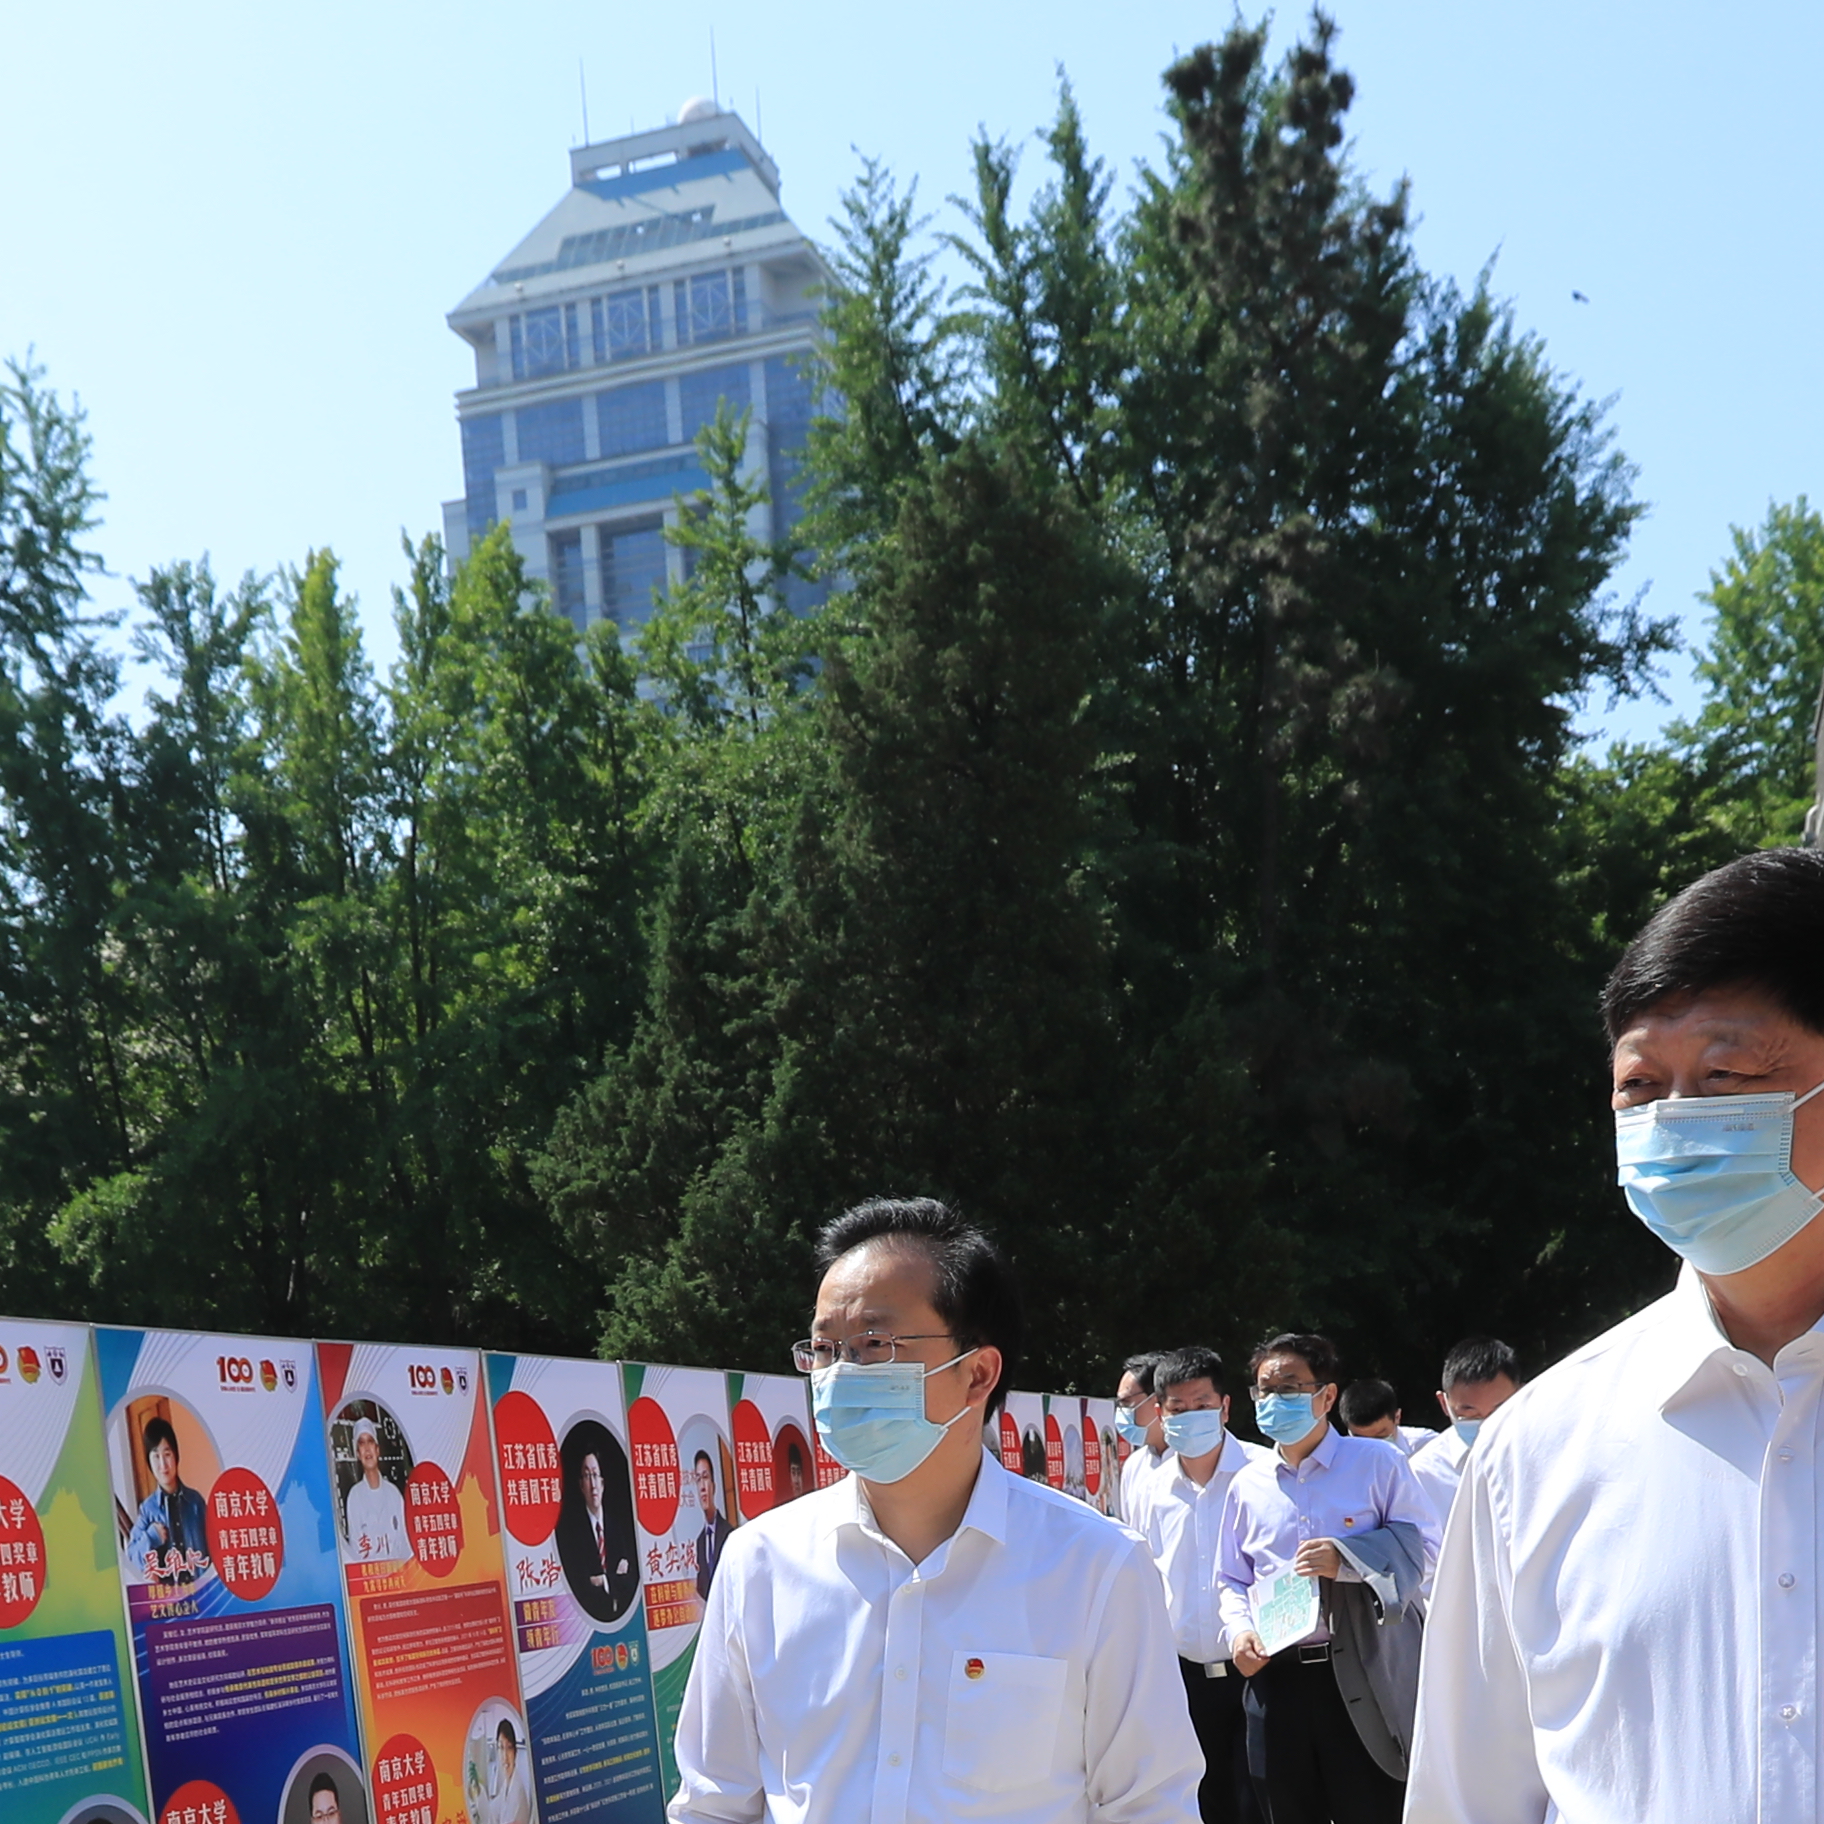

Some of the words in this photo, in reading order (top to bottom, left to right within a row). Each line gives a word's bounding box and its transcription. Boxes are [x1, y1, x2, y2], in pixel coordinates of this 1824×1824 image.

[502, 1443, 558, 1470] 江苏省优秀
[634, 1443, 678, 1467] 江苏省优秀
[506, 1478, 562, 1506] 共青团干部
[638, 1472, 677, 1499] 共青团员
[740, 1467, 774, 1492] 共青团员
[214, 1489, 269, 1518] 南京大学
[409, 1481, 450, 1506] 南京大学
[413, 1511, 458, 1534] 青年五四奖章
[218, 1524, 277, 1551] 青年五四奖章
[416, 1534, 458, 1562] 青年教师
[221, 1550, 277, 1584] 青年教师
[378, 1750, 426, 1784] 南京大学
[381, 1780, 434, 1813] 青年五四奖章
